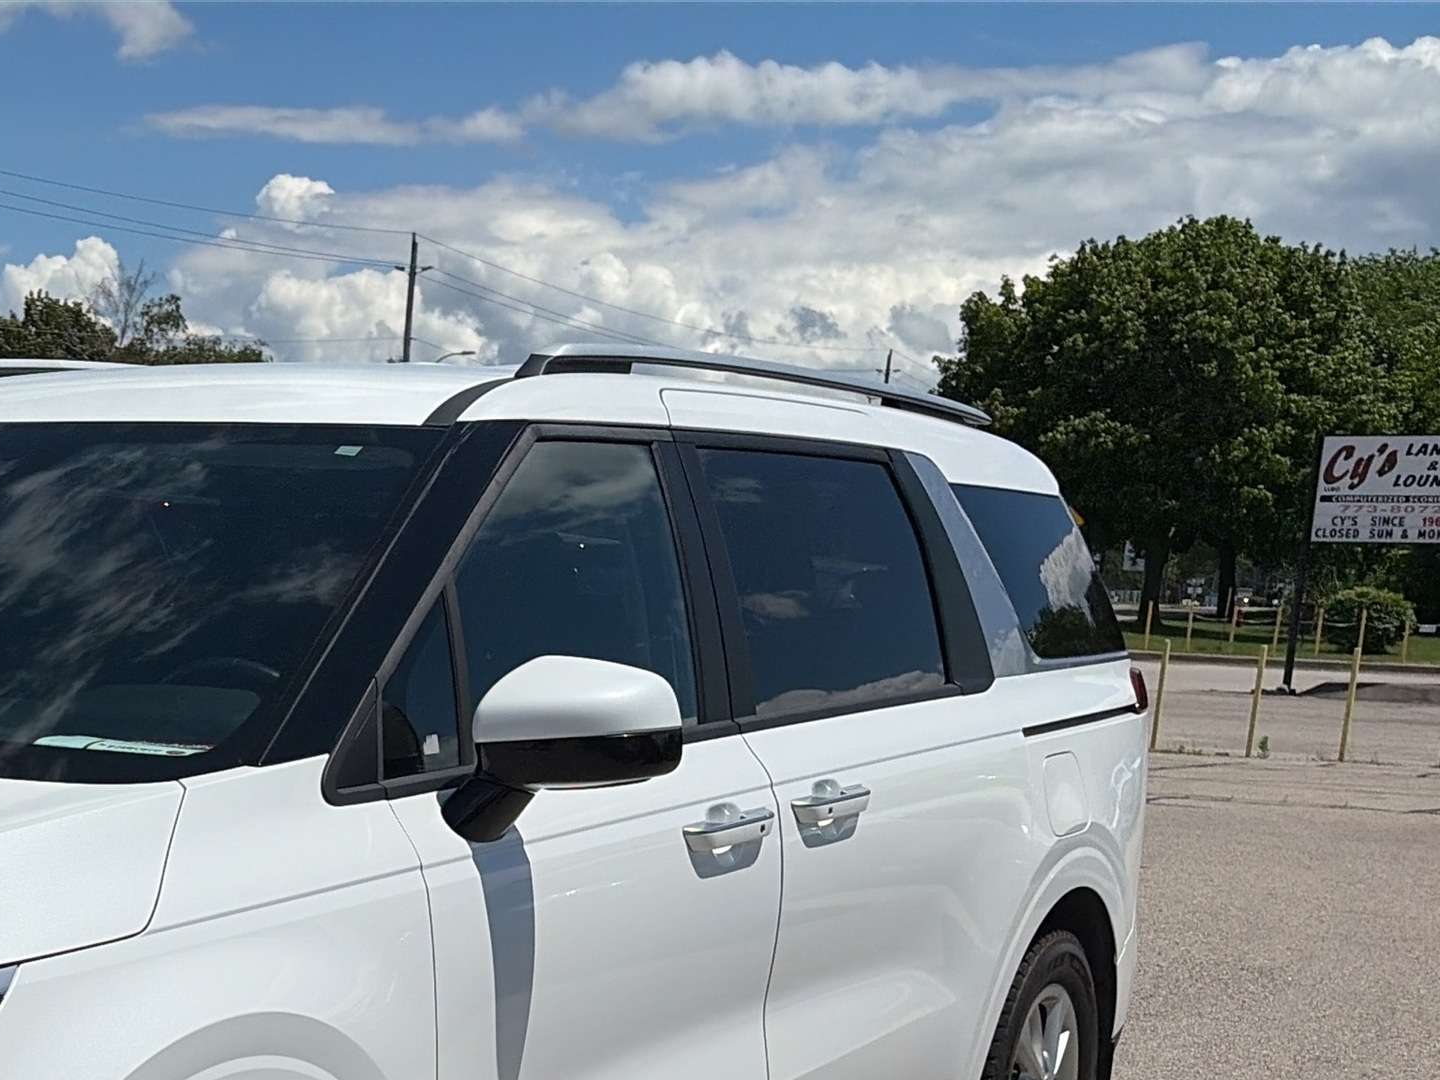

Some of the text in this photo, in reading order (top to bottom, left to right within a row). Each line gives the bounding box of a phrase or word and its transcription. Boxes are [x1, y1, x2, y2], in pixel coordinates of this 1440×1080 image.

[1323, 443, 1398, 490] Cy's
[1427, 460, 1439, 471] &
[1331, 516, 1358, 527] CY'S
[1370, 516, 1406, 527] SINCE
[1314, 528, 1360, 539] CLOSED
[1369, 528, 1393, 539] SUN
[1400, 528, 1408, 539] &
